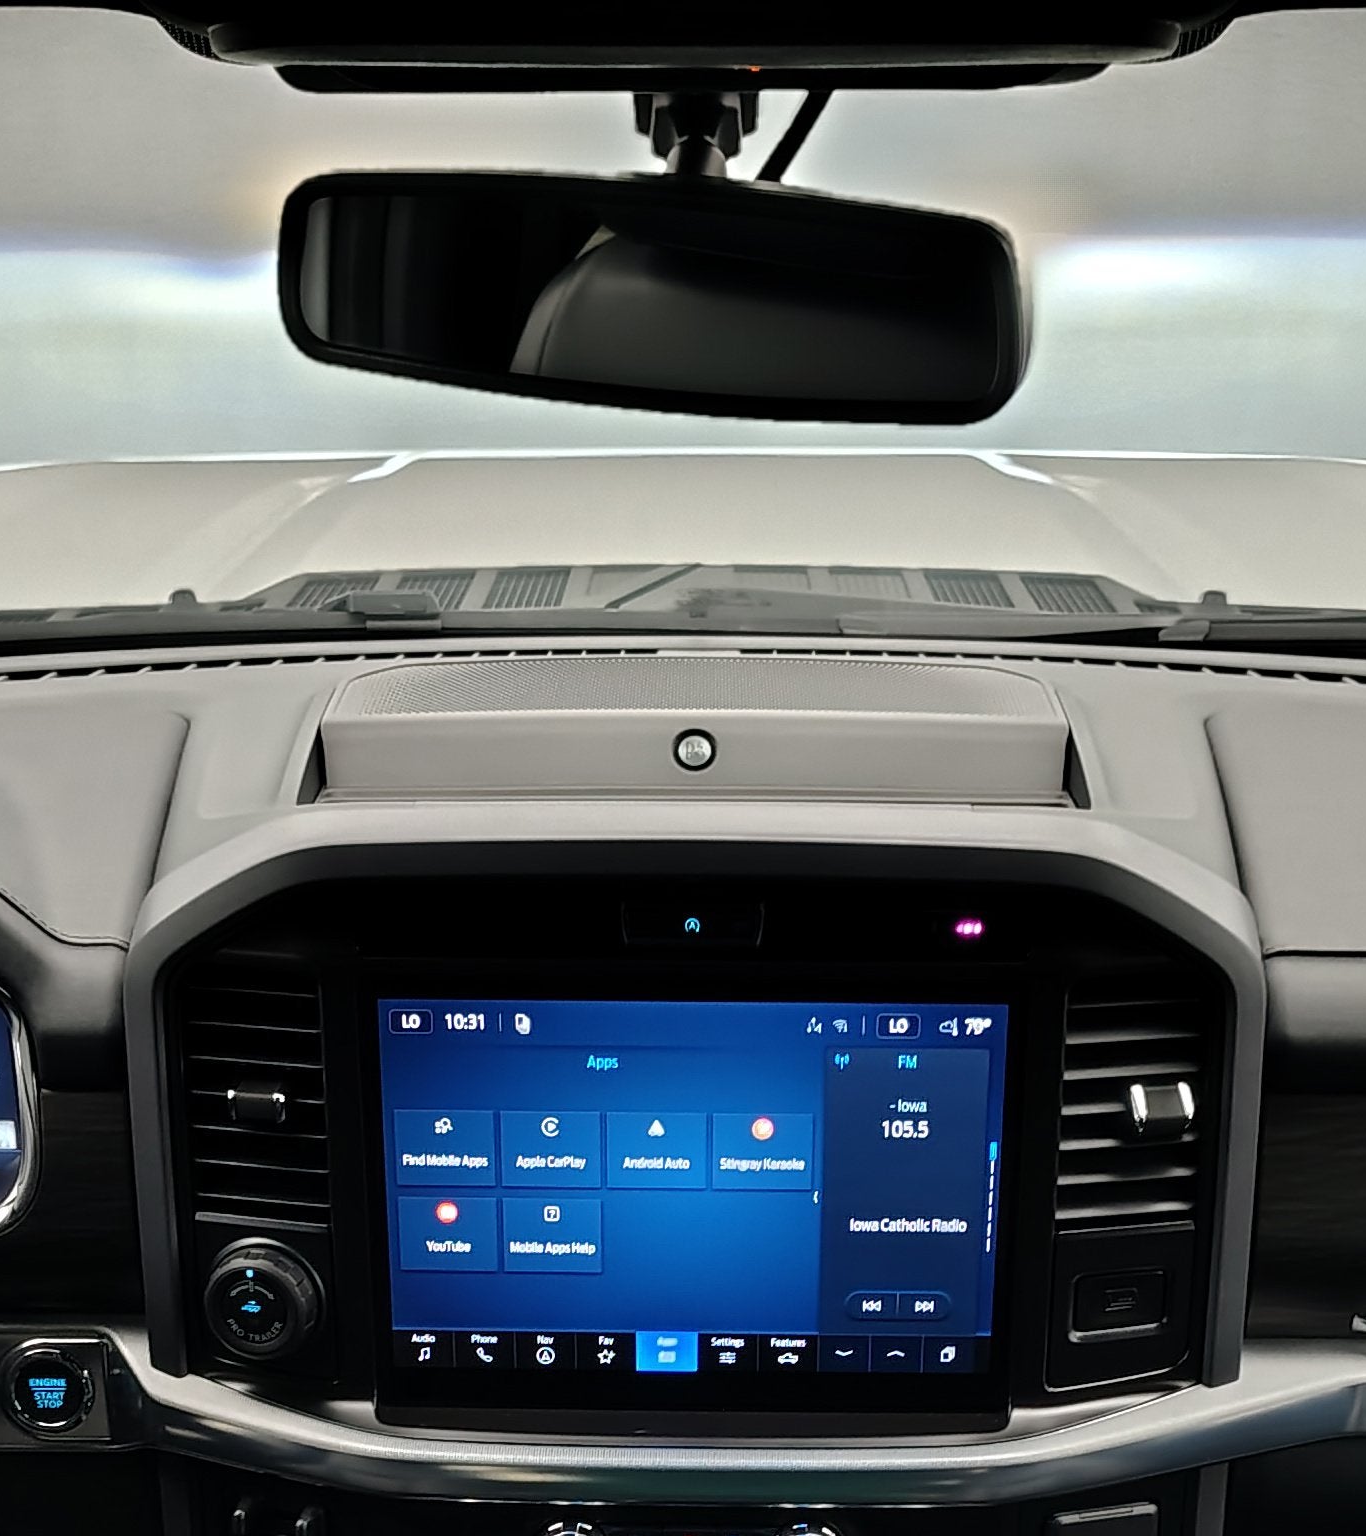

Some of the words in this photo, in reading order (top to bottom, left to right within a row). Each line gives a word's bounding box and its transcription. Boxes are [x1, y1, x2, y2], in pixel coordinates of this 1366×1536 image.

[401, 1013, 421, 1029] LO
[444, 1013, 485, 1030] 10:31
[888, 1018, 909, 1034] LO
[586, 1054, 619, 1071] Apps
[898, 1054, 918, 1070] FM
[897, 1098, 928, 1113] Iowa
[881, 1119, 929, 1139] 105.5
[402, 1153, 425, 1167] Find
[426, 1153, 461, 1167] Mobile
[461, 1154, 489, 1169] Apps
[515, 1155, 546, 1170] Apple
[546, 1155, 586, 1170] CarPlay
[622, 1156, 663, 1169] Android
[664, 1156, 691, 1170] Auto
[719, 1156, 762, 1171] Stingray
[763, 1157, 805, 1171] Karaoke
[849, 1217, 879, 1232] Iowa
[880, 1217, 931, 1233] Catholic
[931, 1218, 968, 1233] Radio
[425, 1240, 472, 1253] YouTube
[509, 1241, 544, 1254] Mobile
[544, 1241, 571, 1255] Apps
[571, 1242, 596, 1256] Help
[226, 1318, 245, 1337] PRO
[411, 1333, 436, 1343] Audio
[470, 1334, 498, 1344] Phone
[536, 1335, 554, 1345] Nav
[598, 1336, 615, 1346] Fav
[710, 1336, 745, 1348] Settings
[770, 1337, 807, 1348] Features
[28, 1378, 68, 1387] ENGINE
[33, 1391, 66, 1401] START
[36, 1400, 64, 1409] STOP
